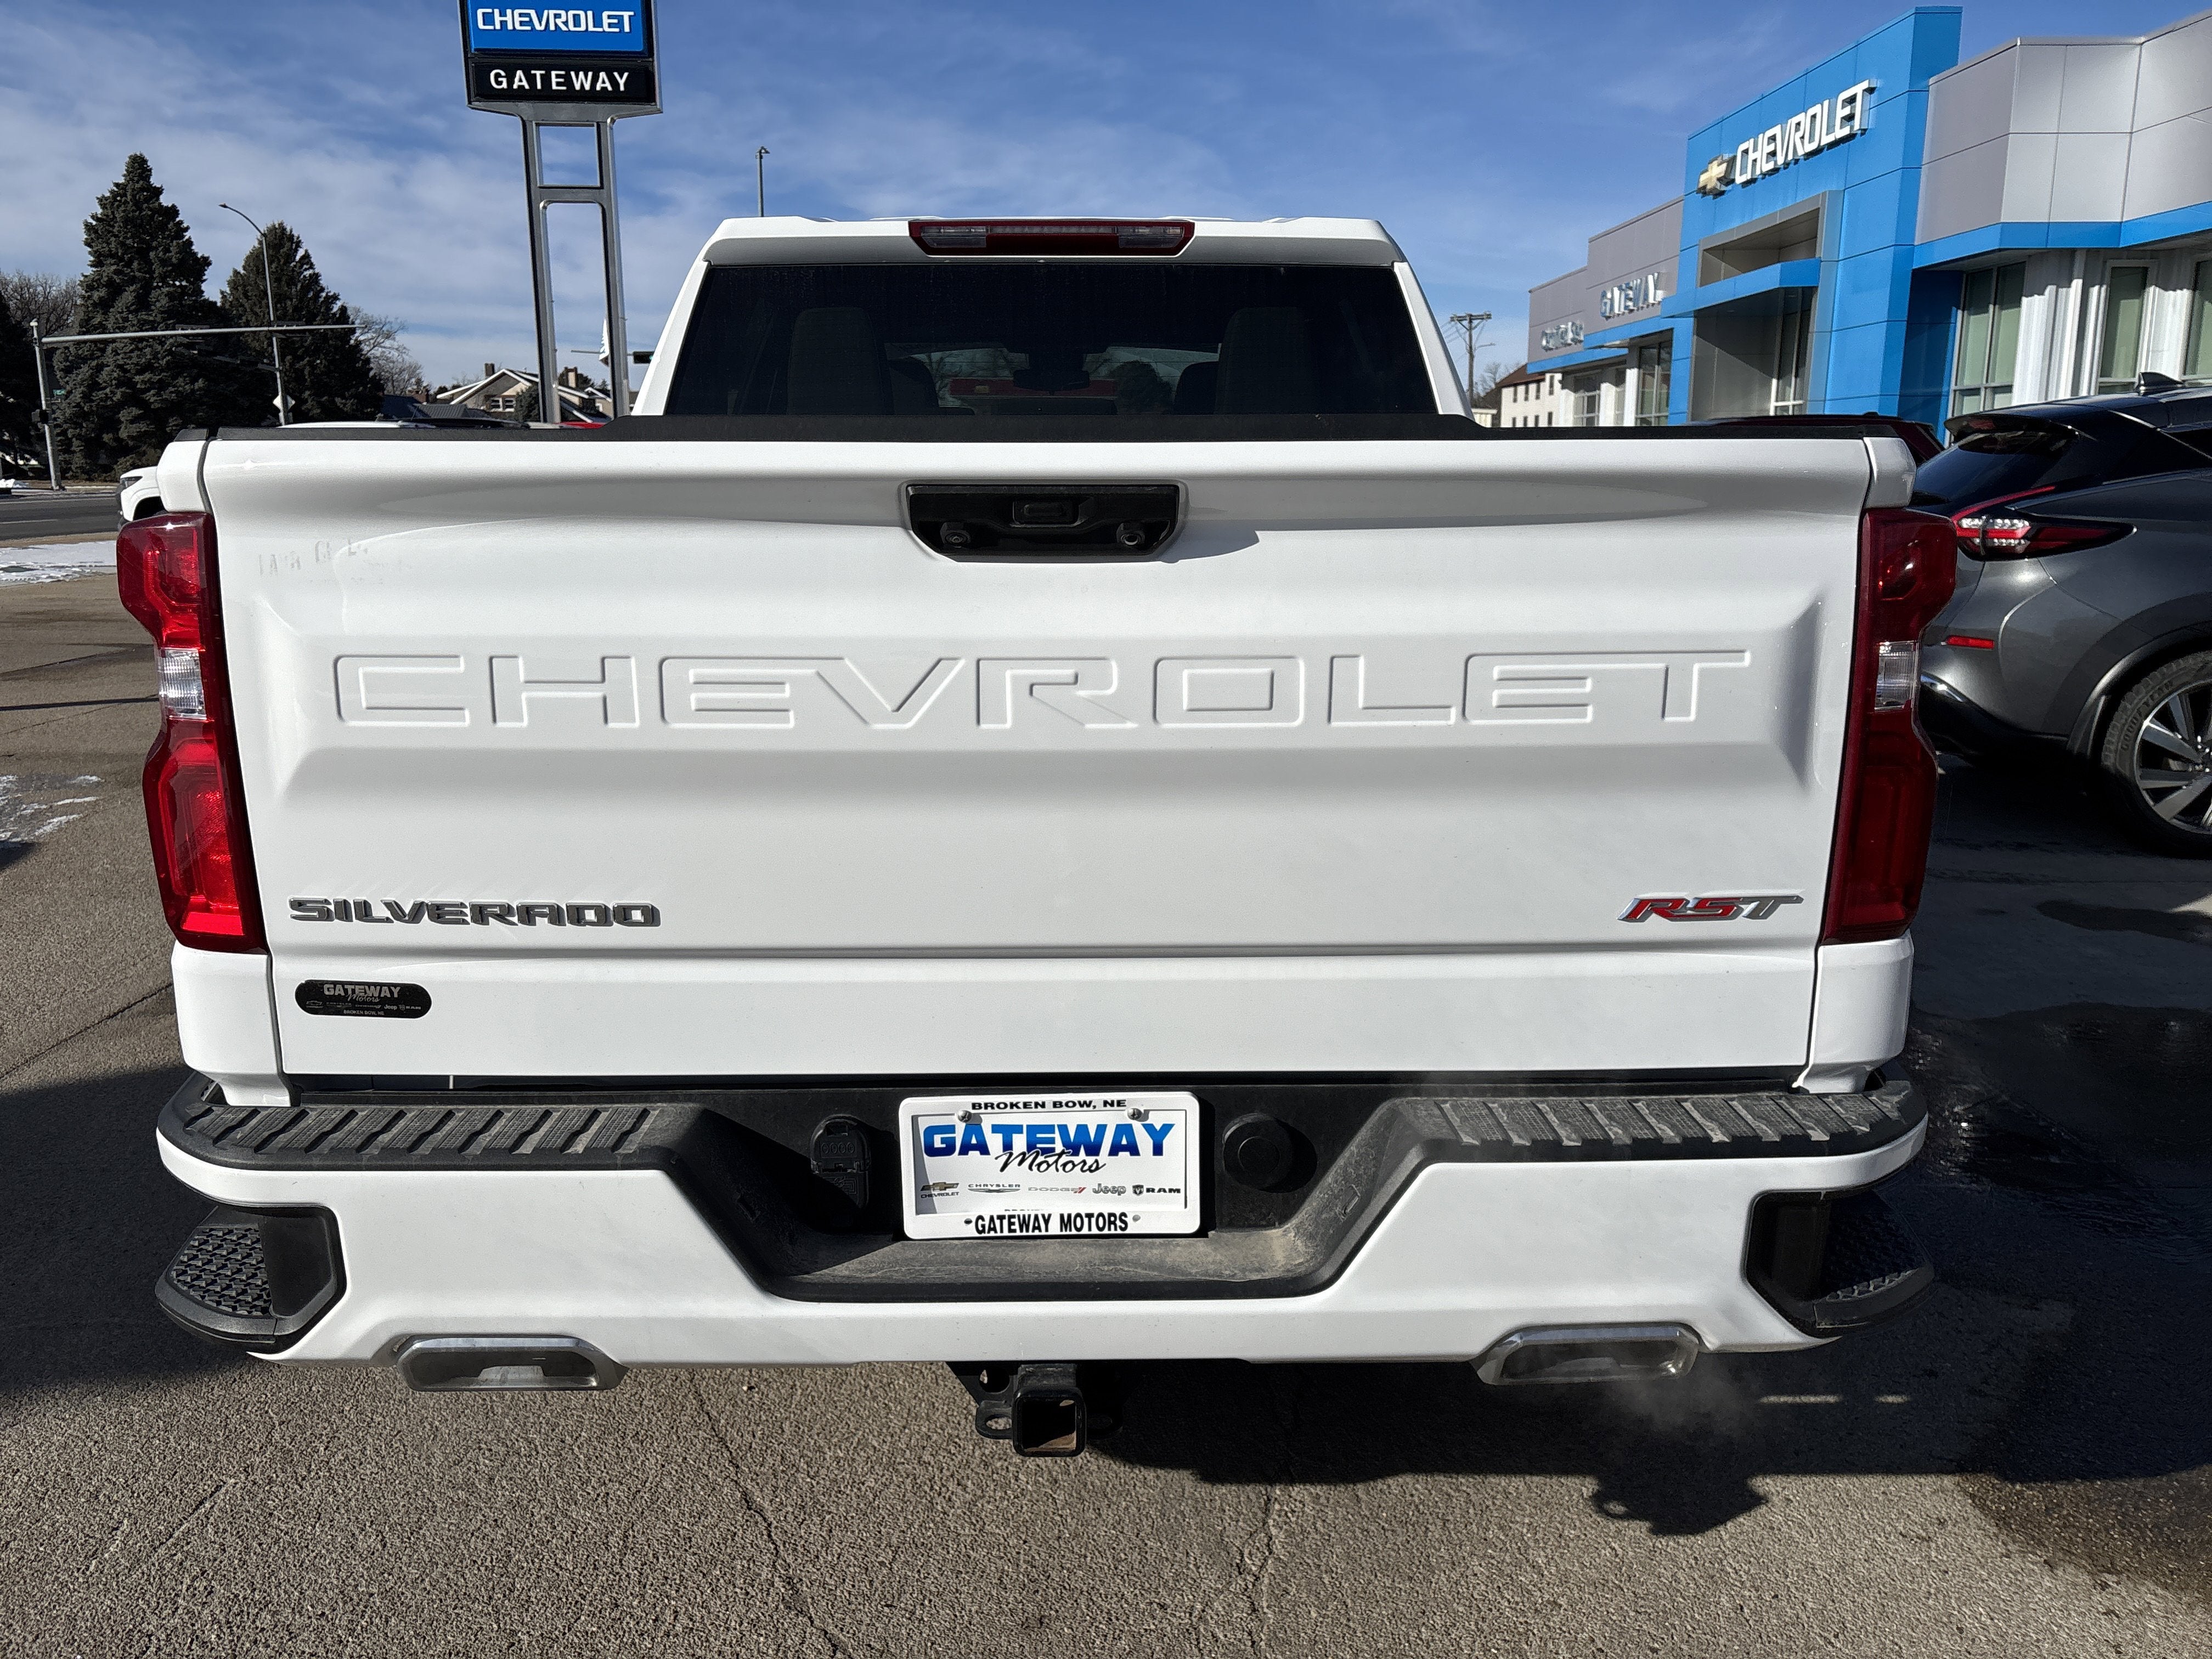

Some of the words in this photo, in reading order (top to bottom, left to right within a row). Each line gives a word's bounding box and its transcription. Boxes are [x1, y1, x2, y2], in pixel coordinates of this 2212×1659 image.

[477, 8, 634, 33] CHEVROLET
[490, 69, 629, 91] GATEWAY
[1735, 78, 1877, 185] CHEVROLET
[333, 650, 1752, 729] CHEVROLET
[289, 897, 661, 927] SILVERADO
[1617, 895, 1804, 923] RST
[323, 984, 401, 998] GATEWAY
[347, 993, 380, 1003] Motors
[971, 1101, 1046, 1110] BROKEN
[1052, 1100, 1097, 1109] BOW,
[1103, 1099, 1127, 1108] NE
[923, 1123, 1176, 1158] GATEWAY
[994, 1149, 1107, 1173] Motors
[1092, 1183, 1127, 1196] Jeep
[974, 1214, 1052, 1234] GATEWAY
[1059, 1211, 1128, 1233] MOTORS
